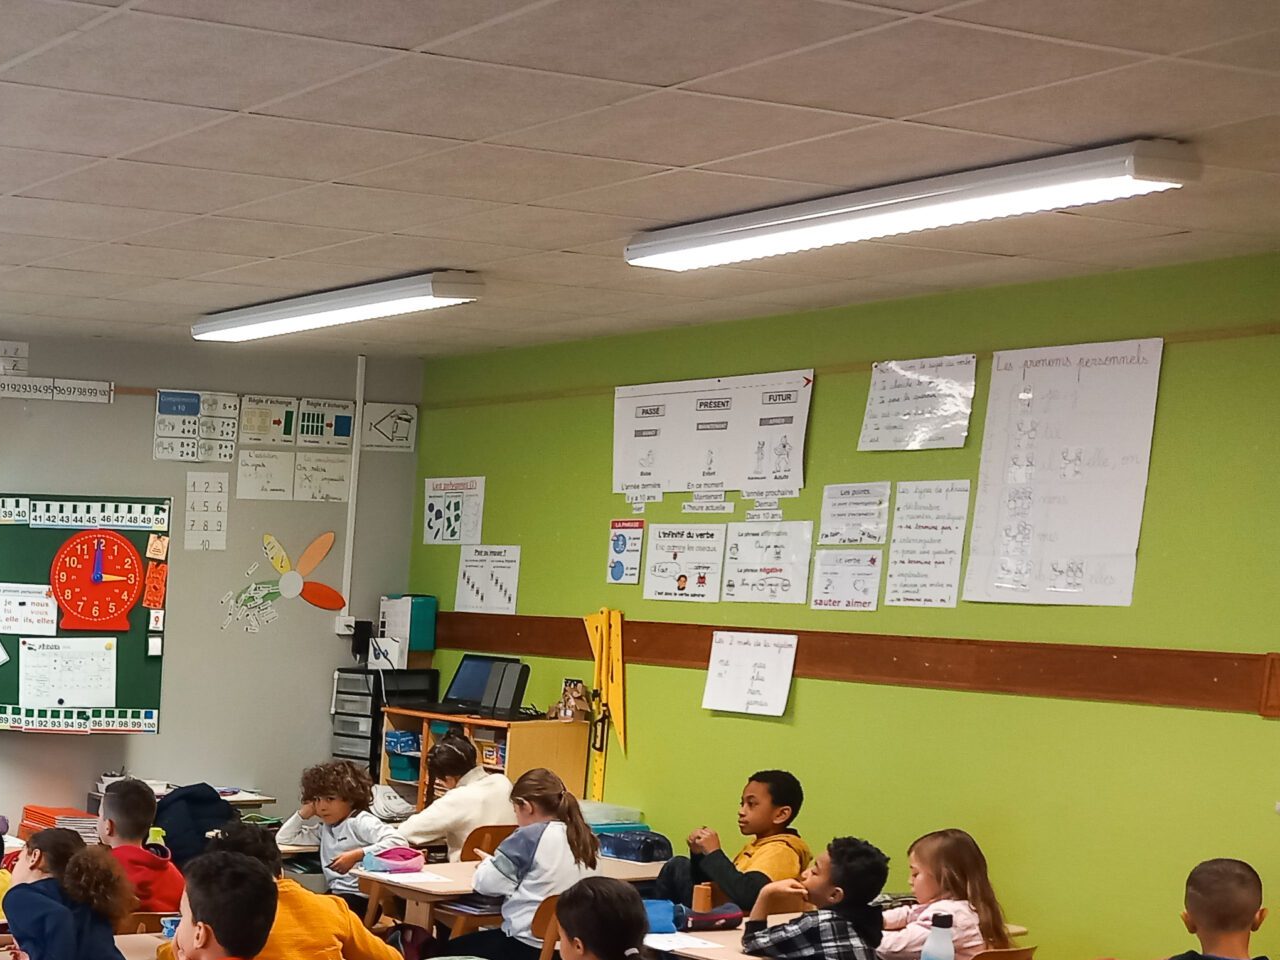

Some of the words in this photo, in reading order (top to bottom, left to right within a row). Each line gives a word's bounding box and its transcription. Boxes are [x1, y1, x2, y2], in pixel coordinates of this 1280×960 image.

[996, 356, 1013, 371] Les
[1023, 357, 1071, 380] pronoms
[1077, 344, 1148, 383] personnels
[768, 394, 792, 402] FUTUR
[699, 400, 730, 409] PRÉSENT
[641, 407, 660, 415] PASSÉ
[192, 481, 196, 492] 1
[205, 482, 210, 493] 2
[218, 482, 223, 493] 3
[190, 501, 195, 512] 4
[203, 501, 209, 512] 5
[217, 502, 222, 512] 6
[2, 510, 13, 518] 39
[16, 510, 26, 518] 40
[32, 515, 42, 523] 41
[46, 515, 56, 523] 42
[59, 515, 70, 523] 43
[73, 515, 83, 523] 44
[86, 515, 97, 524] 45
[101, 514, 111, 523] 46
[114, 515, 125, 523] 47
[127, 516, 138, 524] 48
[141, 516, 152, 525] 49
[154, 517, 165, 525] 50
[190, 520, 195, 530] 7
[203, 521, 209, 531] 8
[216, 521, 222, 531] 9
[686, 531, 694, 539] du
[695, 531, 715, 539] verbe
[76, 544, 88, 554] 11
[93, 539, 106, 550] 12
[200, 540, 210, 551] 10
[113, 545, 118, 555] 1
[64, 557, 77, 567] 10
[124, 558, 131, 568] 2
[60, 572, 67, 582] 9
[128, 574, 135, 584] 3
[64, 589, 71, 600] 8
[121, 591, 128, 601] 4
[77, 602, 84, 612] 7
[109, 603, 116, 613] 5
[814, 599, 841, 607] sauter
[846, 599, 872, 608] aimer
[92, 607, 99, 617] 6
[51, 720, 61, 728] 93
[64, 720, 74, 728] 94
[77, 721, 88, 729] 95
[131, 721, 142, 729] 99
